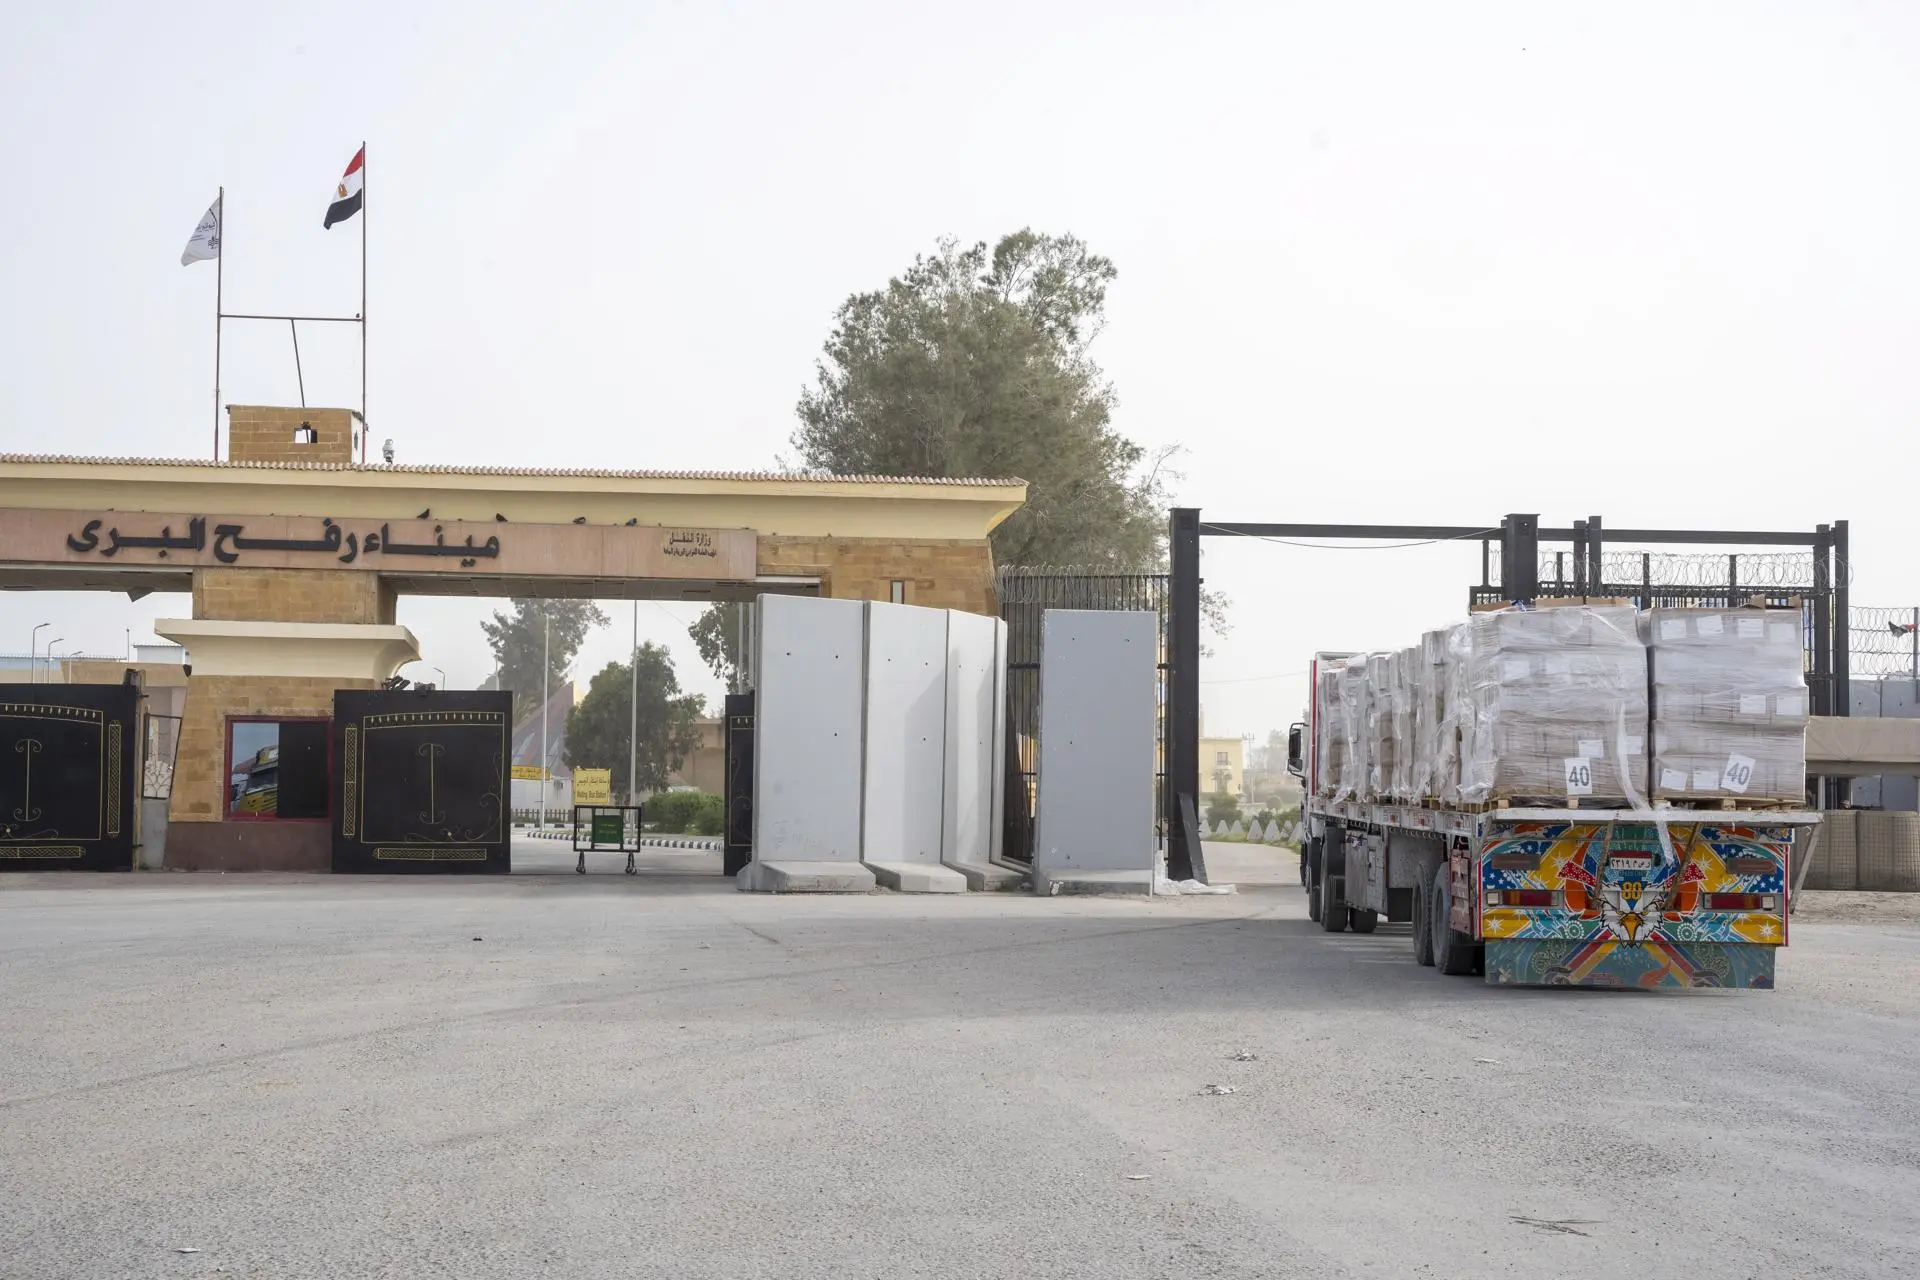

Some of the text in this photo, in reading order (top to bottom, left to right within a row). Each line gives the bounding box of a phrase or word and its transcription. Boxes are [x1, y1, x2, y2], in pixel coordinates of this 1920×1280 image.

[213, 518, 358, 563] رفح
[363, 521, 500, 567] ميناء
[1568, 765, 1590, 787] 40
[1726, 762, 1750, 786] 40
[1622, 881, 1642, 900] 80
